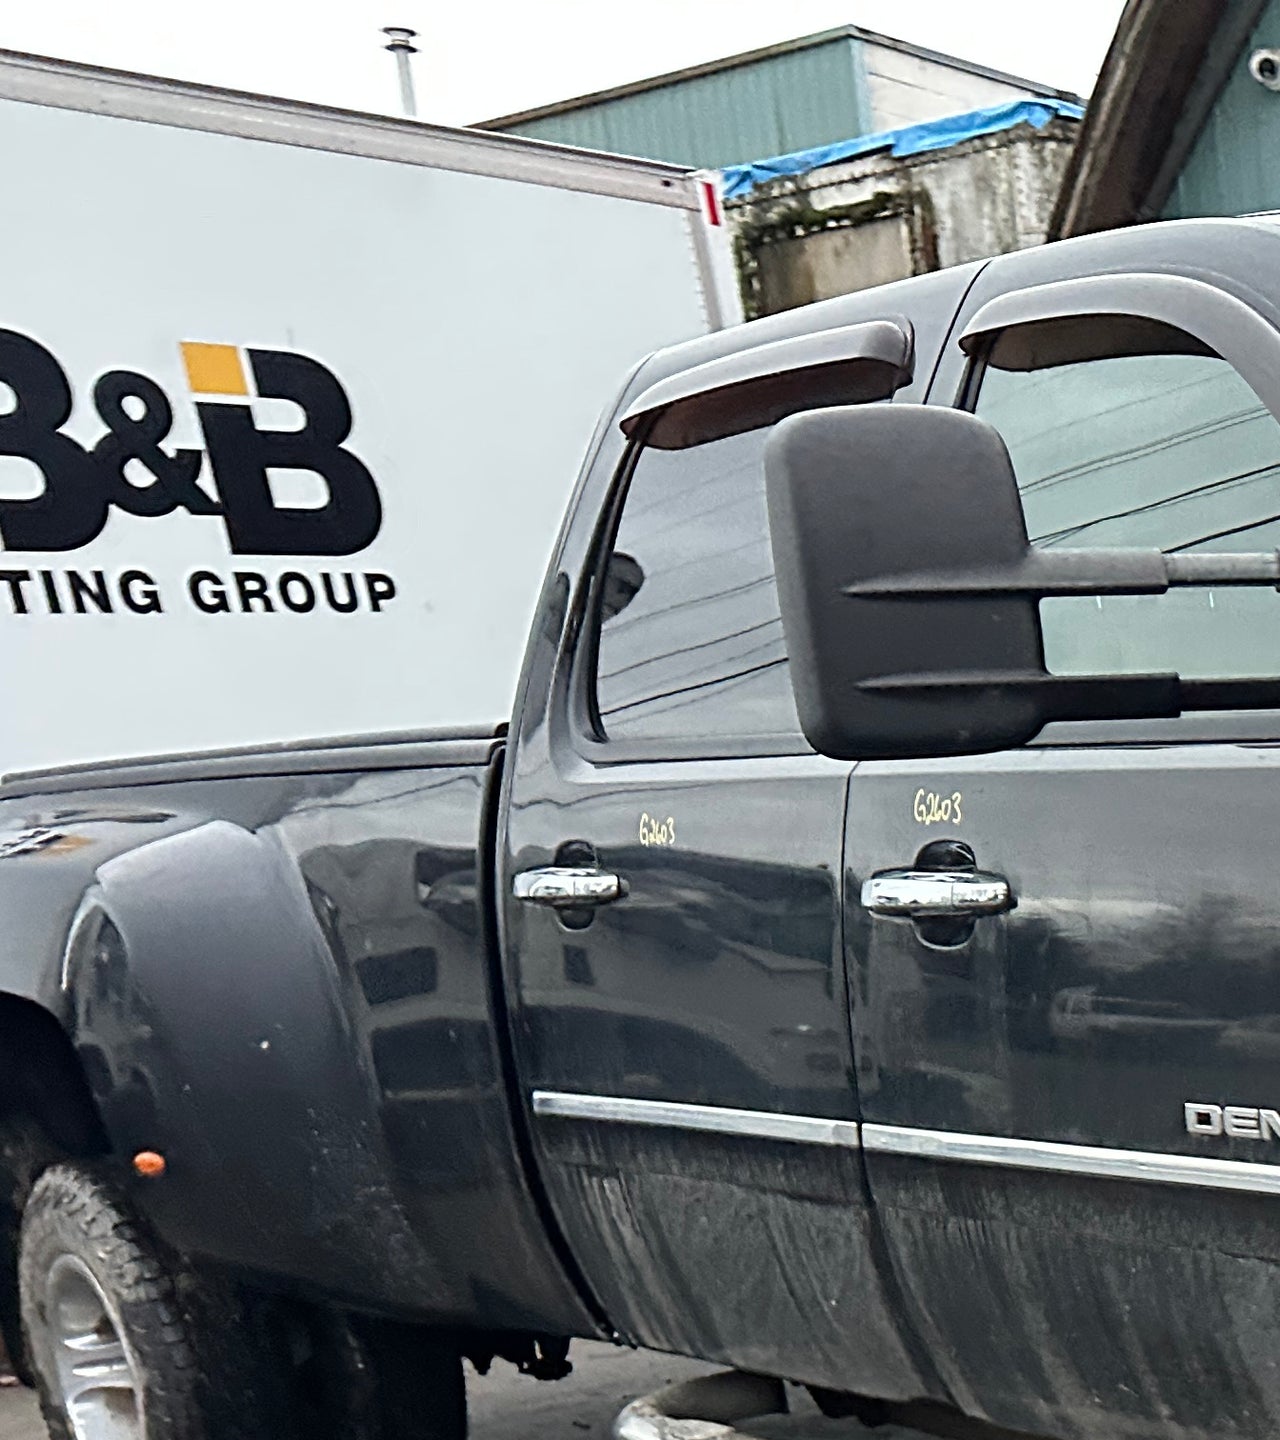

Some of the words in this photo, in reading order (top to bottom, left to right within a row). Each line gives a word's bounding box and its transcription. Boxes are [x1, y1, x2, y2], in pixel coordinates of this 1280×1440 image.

[189, 571, 397, 614] GROUP
[913, 789, 962, 824] G2603
[638, 814, 675, 845] G2603
